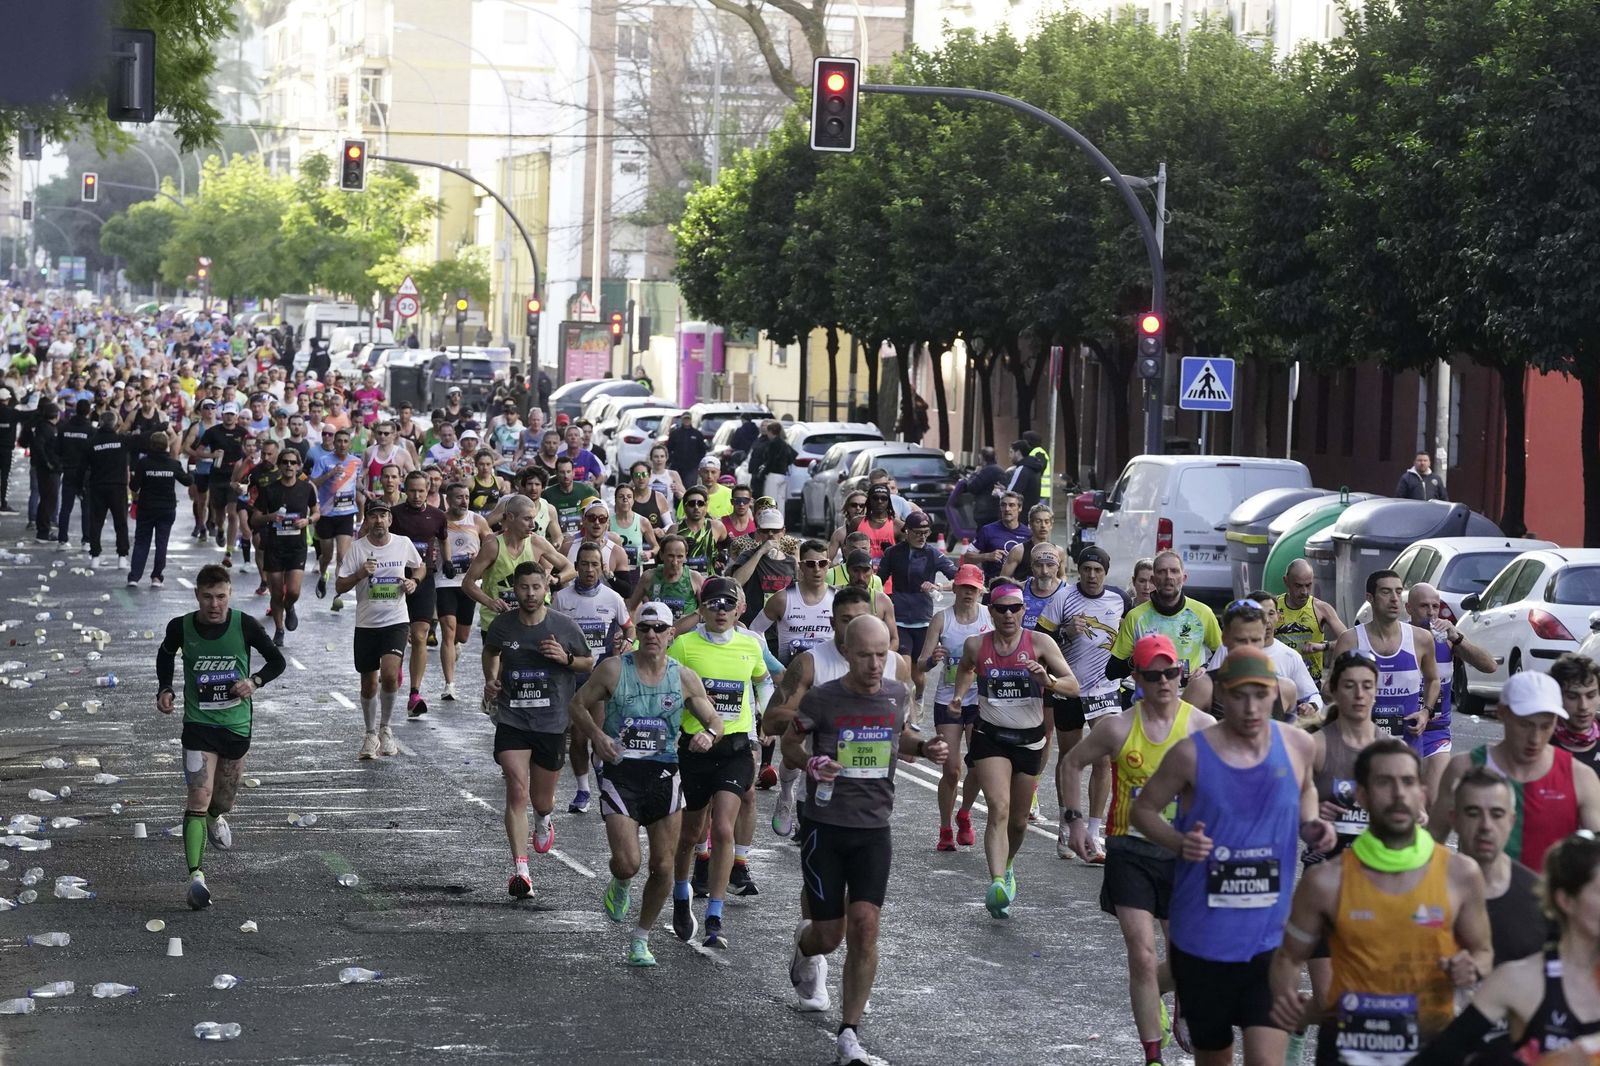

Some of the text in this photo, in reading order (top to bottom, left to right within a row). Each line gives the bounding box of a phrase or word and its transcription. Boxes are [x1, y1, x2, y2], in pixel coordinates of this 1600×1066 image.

[94, 442, 121, 452] VOLUNTEER
[145, 470, 174, 478] VOLUNTEER
[1188, 552, 1228, 562] 9177 MFY
[372, 591, 396, 599] ARNAUD
[788, 625, 831, 633] MICHELETTI
[192, 660, 237, 671] EDERA
[211, 673, 235, 681] ZURICH
[1001, 669, 1025, 677] ZURICH
[717, 681, 741, 689] ZURICH
[212, 693, 228, 701] ALE
[517, 689, 541, 699] MÁRIO
[997, 689, 1021, 698] SANTI
[716, 703, 741, 712] TRAKAS
[1089, 698, 1115, 712] MILTON
[636, 718, 663, 727] ZURICH
[629, 738, 657, 749] STEVE
[852, 756, 877, 767] ETOR
[1234, 847, 1272, 859] ZURICH
[1220, 878, 1270, 893] ANTONI
[1363, 997, 1409, 1010] ZURICH
[1335, 1032, 1418, 1051] ANTONIO J
